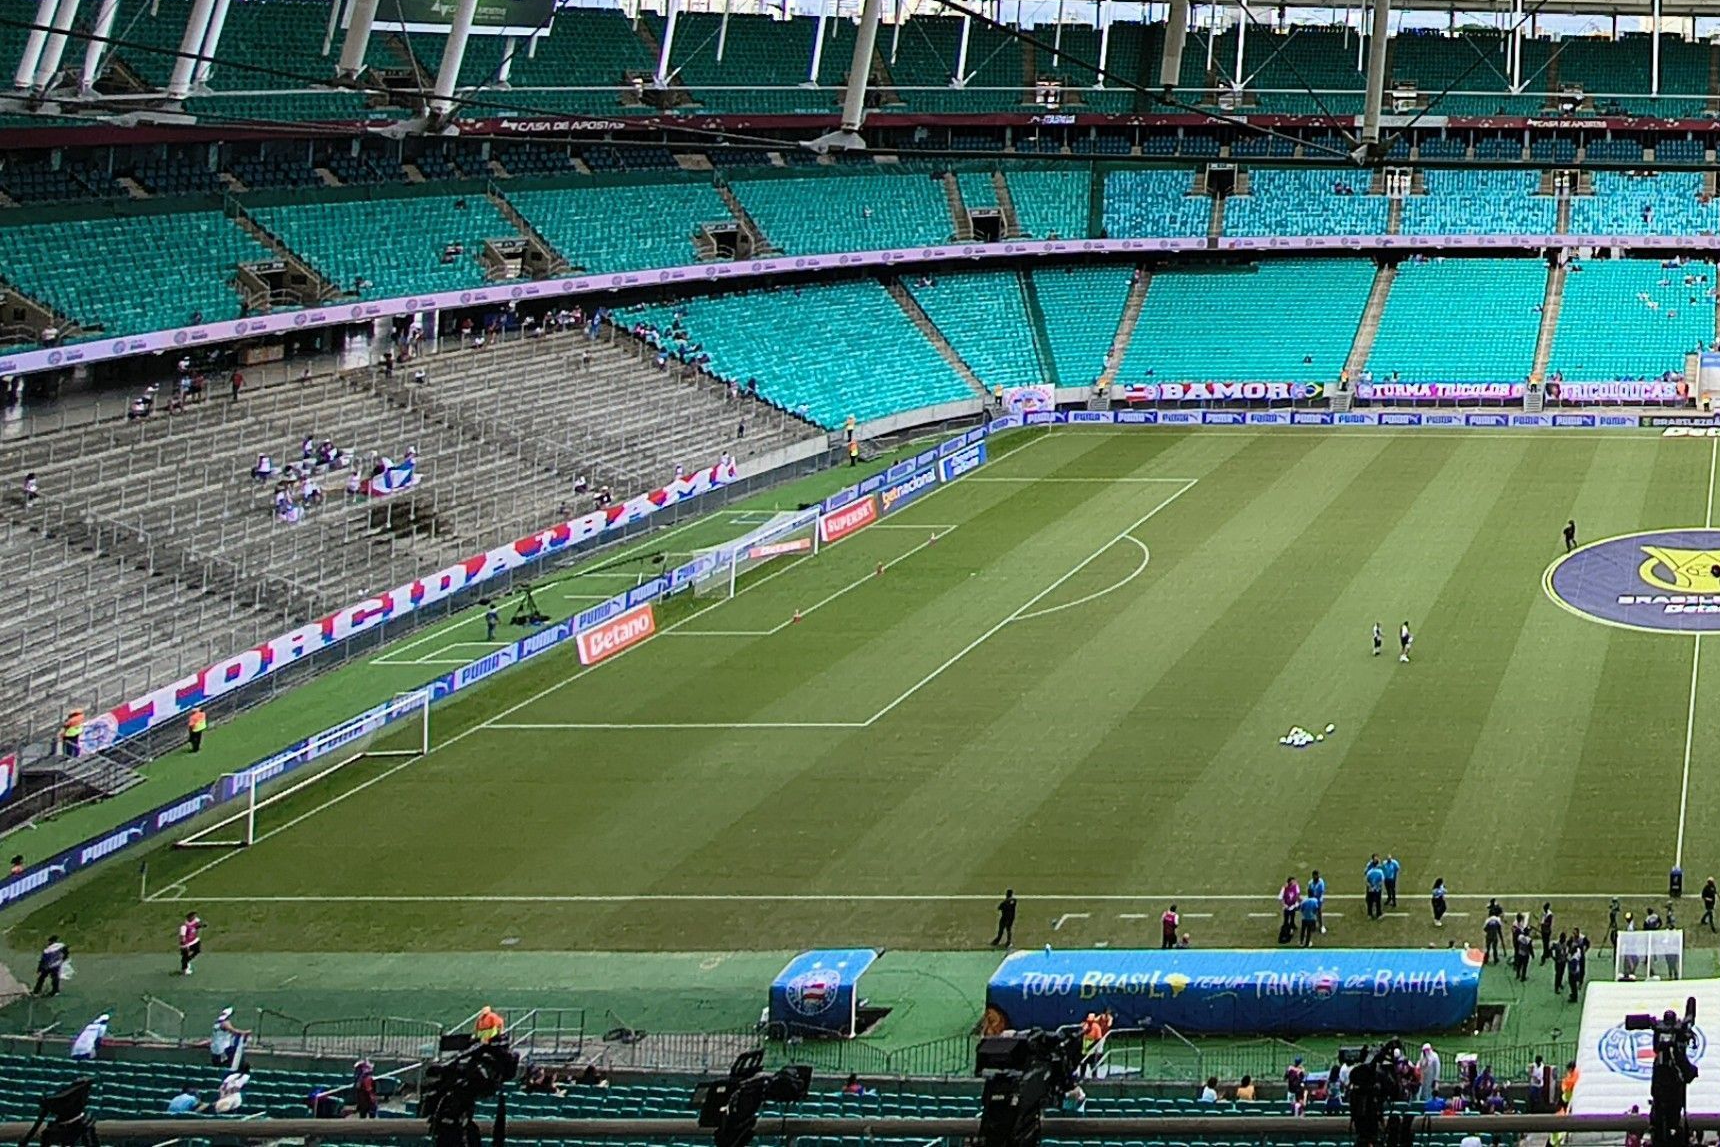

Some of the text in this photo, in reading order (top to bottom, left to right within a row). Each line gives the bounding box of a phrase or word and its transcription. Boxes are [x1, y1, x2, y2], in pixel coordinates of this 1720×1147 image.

[518, 122, 551, 132] CASA
[553, 121, 570, 131] DE
[1162, 382, 1290, 400] BAMOR
[1373, 383, 1432, 397] TURMA
[1562, 382, 1676, 399] TRICOLOUCAS
[882, 467, 936, 510] betnacional
[579, 600, 611, 628] PUMA
[129, 546, 516, 732] TORCIDA
[523, 625, 559, 655] PUMA
[589, 613, 650, 657] Betano
[462, 655, 499, 684] PUMA
[158, 799, 201, 829] PUMA
[82, 830, 128, 865] PUMA
[1, 867, 49, 903] PUMA
[1022, 971, 1076, 1001] TODO
[1079, 969, 1165, 1000] BRASIL
[1373, 968, 1449, 998] BAHIA
